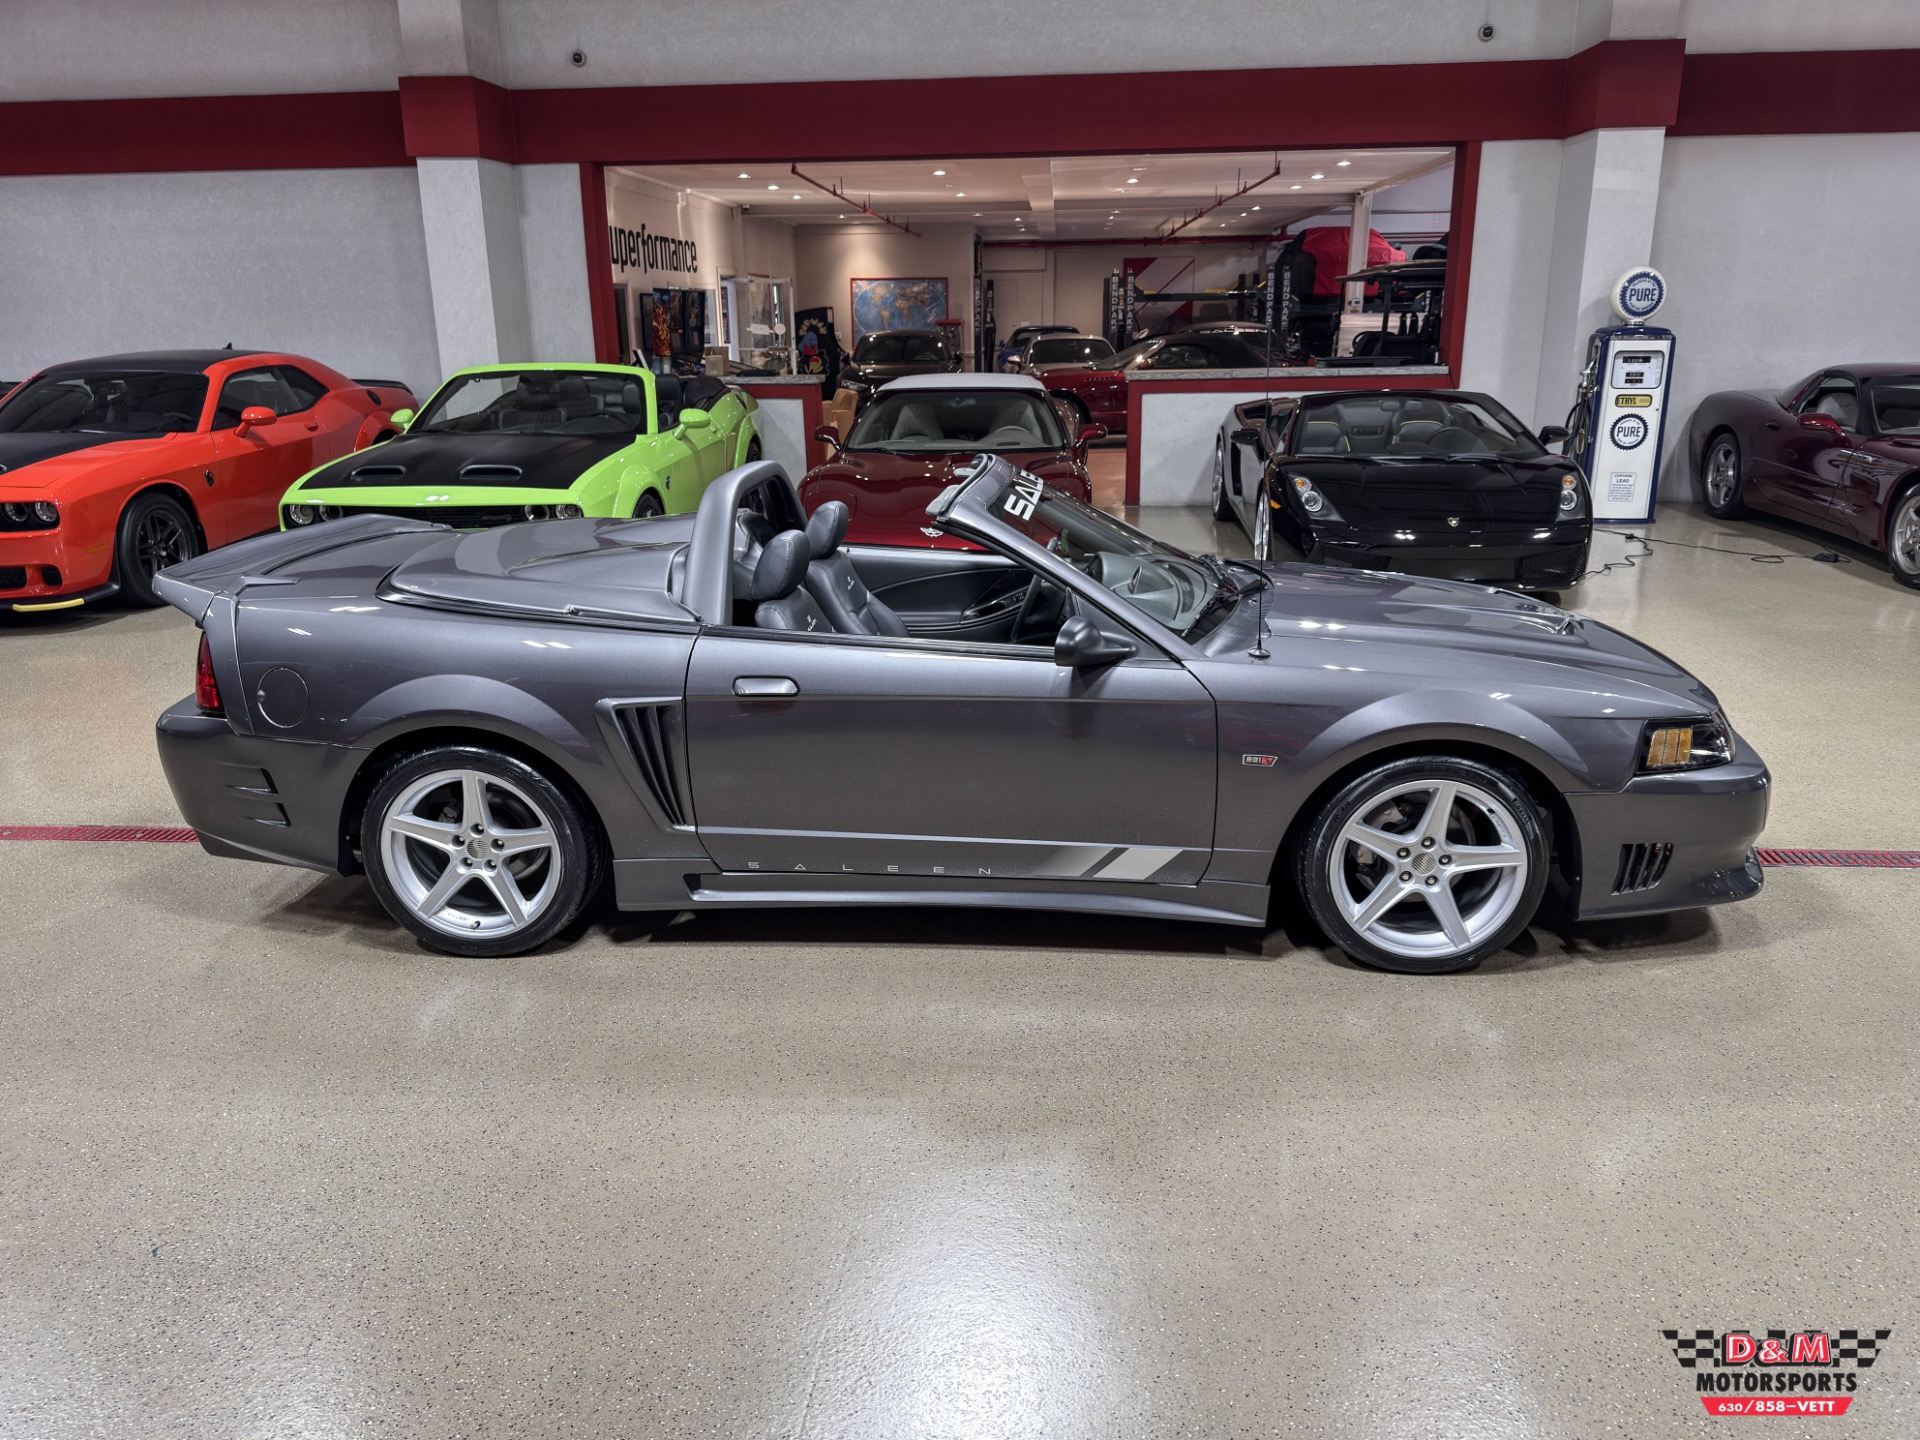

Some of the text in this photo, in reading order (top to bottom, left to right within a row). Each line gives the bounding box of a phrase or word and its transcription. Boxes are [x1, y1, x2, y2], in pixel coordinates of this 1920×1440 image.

[609, 223, 698, 274] uperformance
[1628, 288, 1657, 302] PURE
[1616, 426, 1642, 438] PURE
[748, 861, 991, 875] SALEEN
